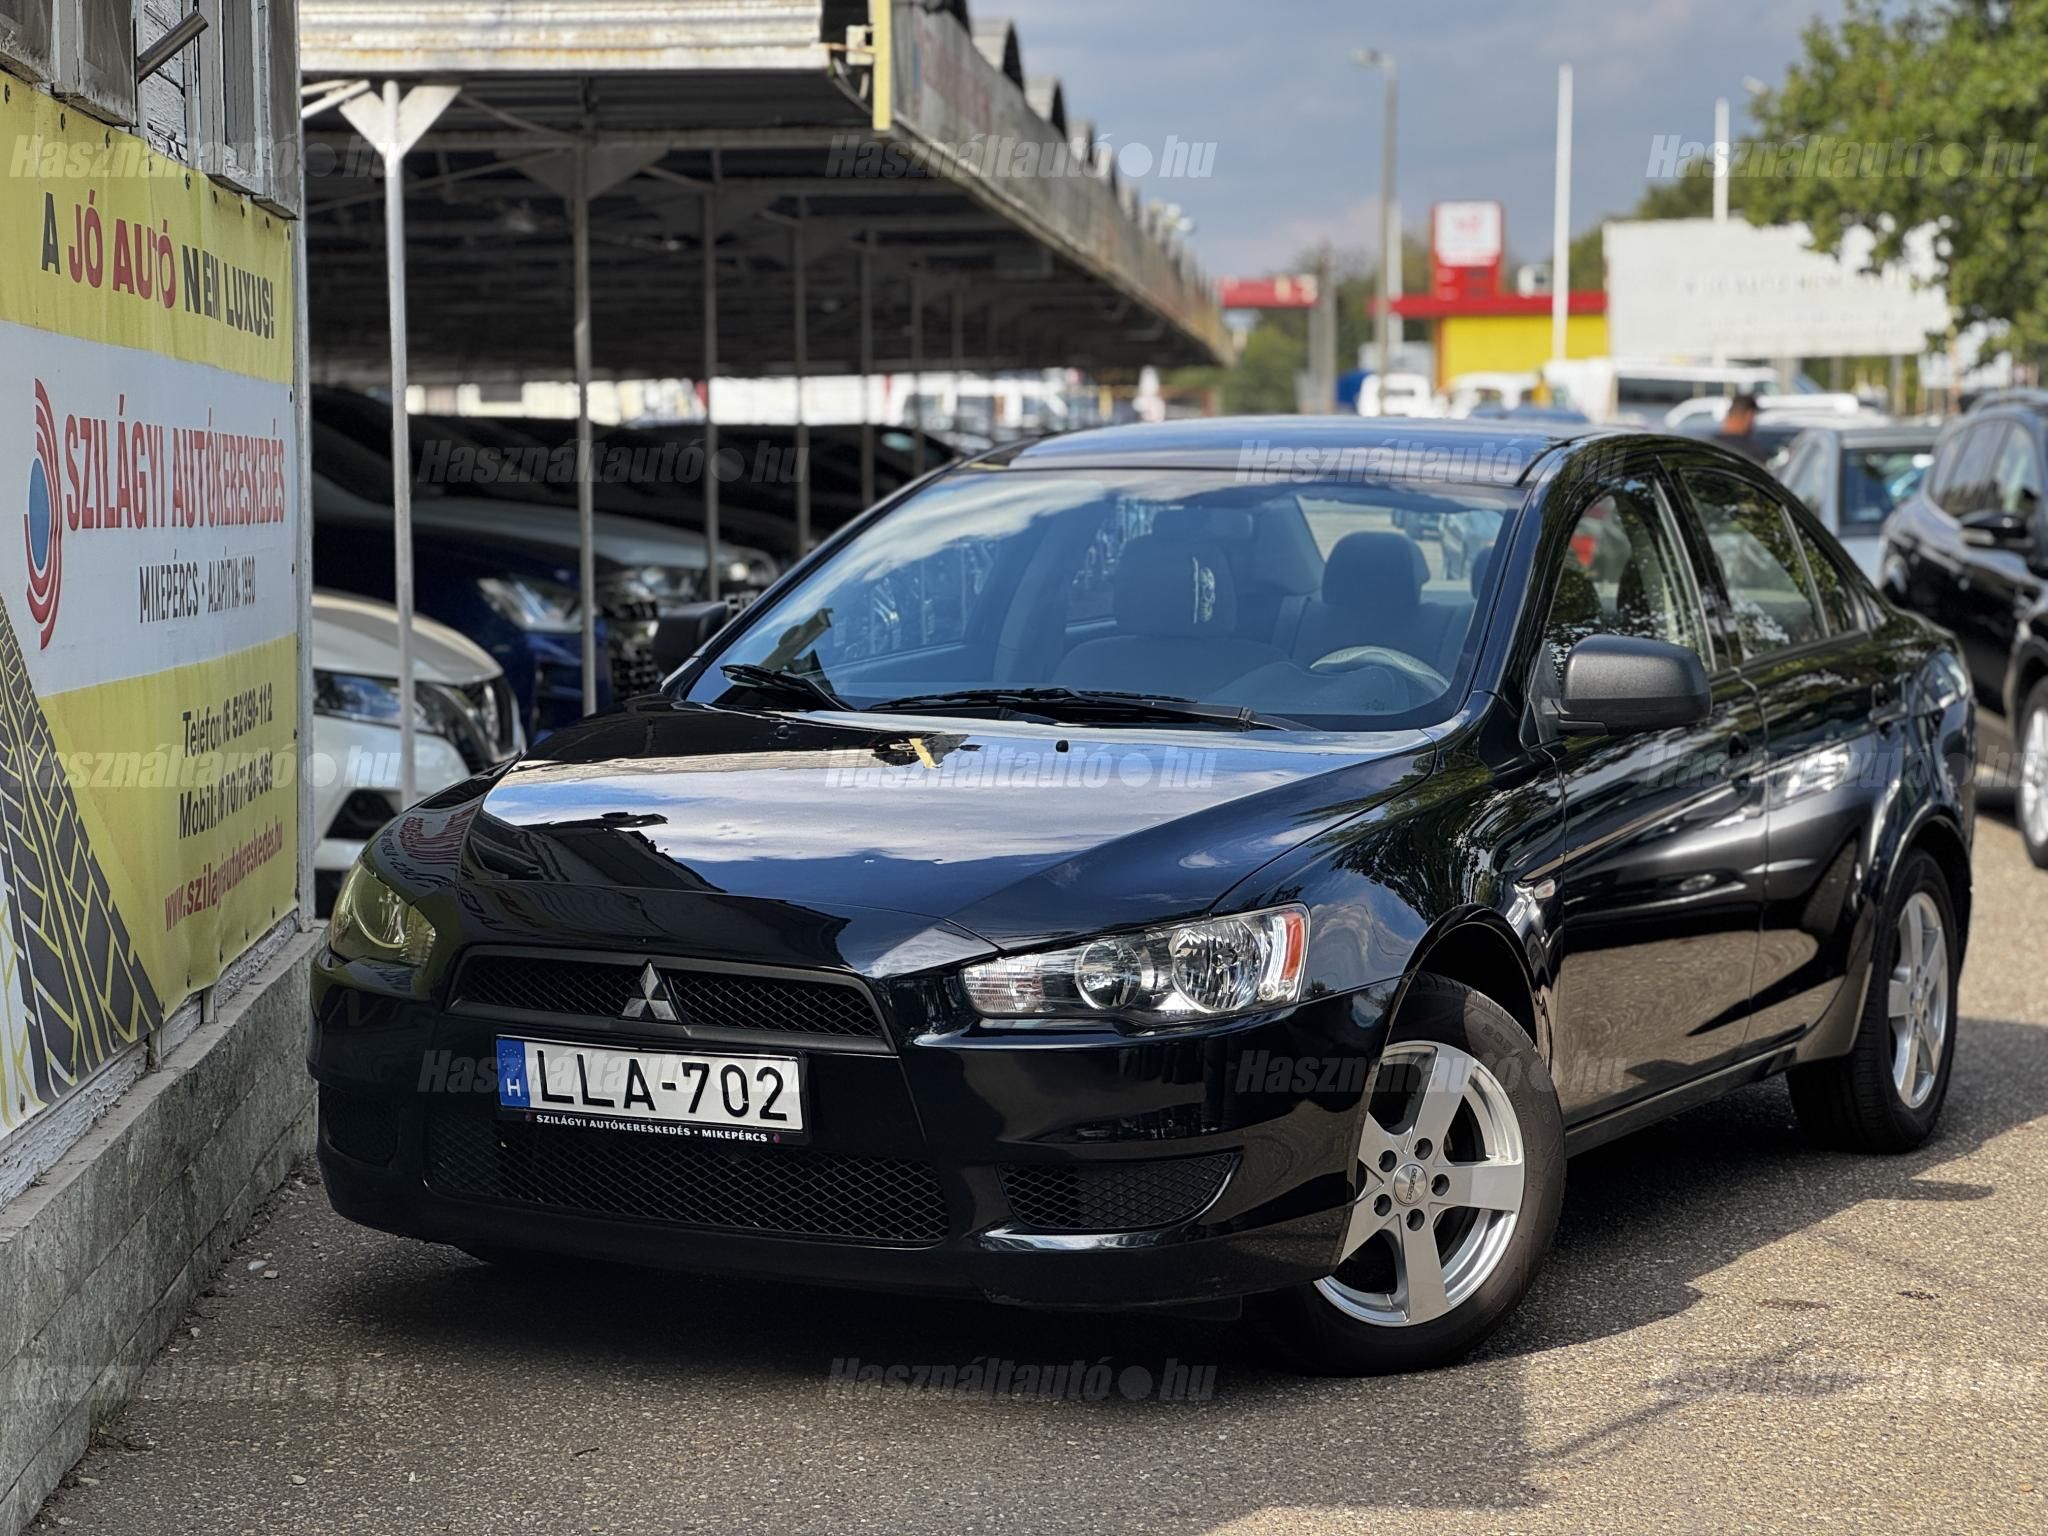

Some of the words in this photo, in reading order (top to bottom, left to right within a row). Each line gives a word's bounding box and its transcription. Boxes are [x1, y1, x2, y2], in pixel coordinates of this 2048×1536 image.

[41, 192, 60, 275] A
[68, 189, 103, 288] JÓ
[113, 219, 176, 309] AUTÓ
[182, 244, 221, 322] NEM
[223, 262, 275, 339] LUXUS!
[65, 394, 165, 531] SZILÁGYI
[172, 407, 285, 528] AUTÓKERESKEDÉS
[139, 548, 198, 623] MIKEPÉRCS
[179, 783, 217, 839] Mobil:
[506, 1079, 521, 1097] H
[537, 1050, 787, 1121] LLA-702
[536, 1114, 587, 1128] SZILÁGYI
[589, 1119, 691, 1136] AUTÓKERESKEDÉS
[702, 1128, 768, 1142] MIKEPÉRCS
